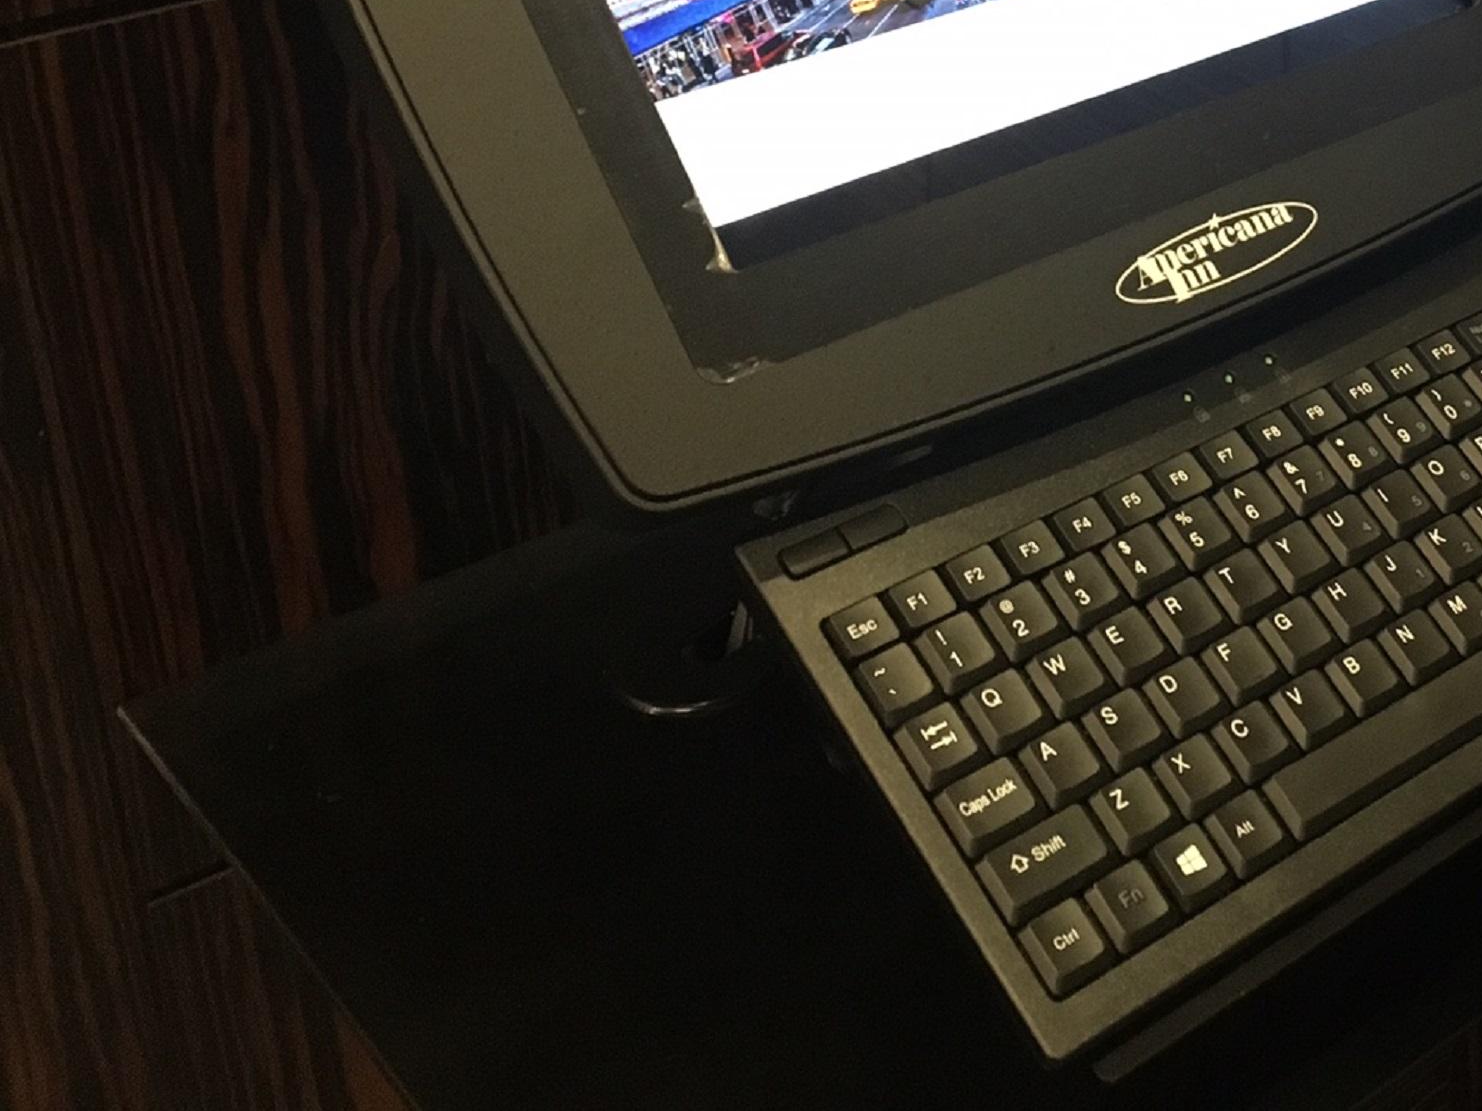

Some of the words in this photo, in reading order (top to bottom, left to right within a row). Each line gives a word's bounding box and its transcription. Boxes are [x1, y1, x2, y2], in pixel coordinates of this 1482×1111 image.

[1136, 203, 1294, 291] Americana
[1167, 259, 1222, 303] Inn
[1431, 343, 1456, 360] F12
[1390, 362, 1414, 380] F11
[1349, 382, 1373, 399] F10
[1306, 405, 1325, 420] F9
[1443, 404, 1458, 420] 0
[1262, 425, 1282, 440] F8
[1396, 428, 1411, 443] 9
[1217, 447, 1233, 463] F7
[1347, 453, 1362, 468] 8
[1427, 460, 1444, 475] O
[1169, 469, 1189, 486] F6
[1295, 478, 1307, 494] 7
[1121, 492, 1142, 508] F5
[1245, 504, 1260, 519] 6
[1325, 510, 1344, 528] U
[1072, 516, 1092, 533] F4
[1189, 531, 1205, 547] 5
[1428, 528, 1447, 545] K
[1019, 541, 1040, 558] F3
[1275, 538, 1291, 554] Y
[1134, 560, 1147, 574] 4
[1385, 555, 1397, 572] J
[963, 567, 985, 584] F2
[1218, 567, 1234, 584] T
[1074, 588, 1091, 605] 3
[1327, 582, 1347, 601] H
[906, 592, 928, 610] F1
[1163, 596, 1183, 615] R
[1447, 595, 1467, 614] M
[847, 619, 878, 639] Esc
[1012, 619, 1030, 637] 2
[1274, 613, 1293, 631] G
[1105, 625, 1125, 645] E
[1395, 625, 1415, 643] N
[950, 651, 963, 667] 1
[1217, 642, 1231, 662] F
[1043, 654, 1066, 675] W
[1343, 656, 1361, 674] B
[1159, 675, 1178, 693] D
[981, 688, 1003, 708] Q
[1286, 687, 1303, 705] V
[1100, 706, 1119, 725] S
[1230, 719, 1249, 738] C
[1040, 741, 1057, 761] A
[1171, 753, 1191, 774] X
[958, 789, 992, 818] Caps
[987, 778, 1018, 803] Lock
[1109, 788, 1129, 810] Z
[1236, 820, 1255, 838] Alt
[1030, 835, 1067, 862] Shift
[1118, 884, 1146, 908] Fn
[1053, 928, 1080, 950] Ctrl
